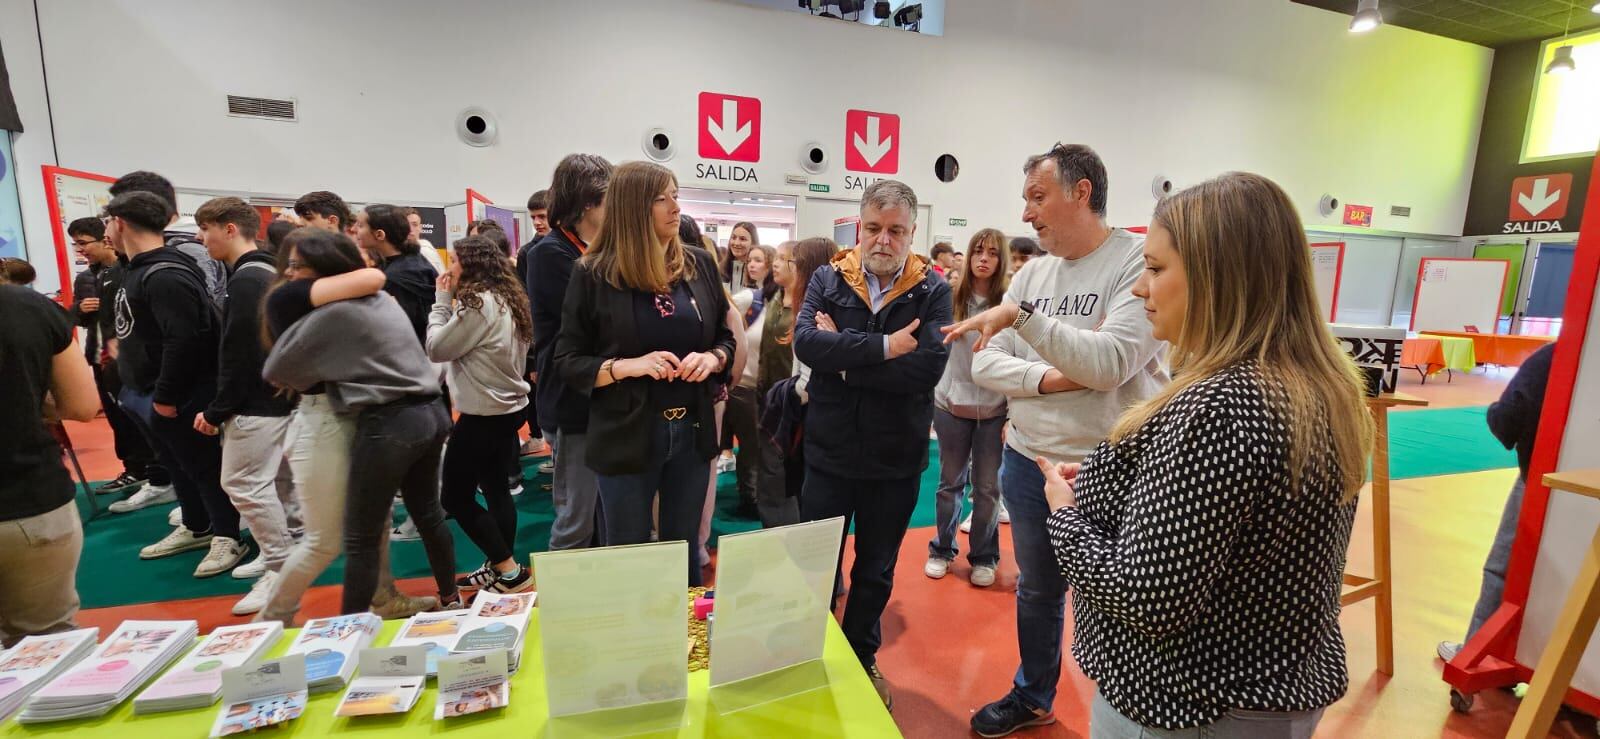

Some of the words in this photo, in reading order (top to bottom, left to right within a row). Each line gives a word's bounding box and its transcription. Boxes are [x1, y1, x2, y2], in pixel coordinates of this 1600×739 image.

[696, 163, 758, 183] SALIDA
[1351, 210, 1365, 220] BAR
[1503, 220, 1562, 233] SALIDA
